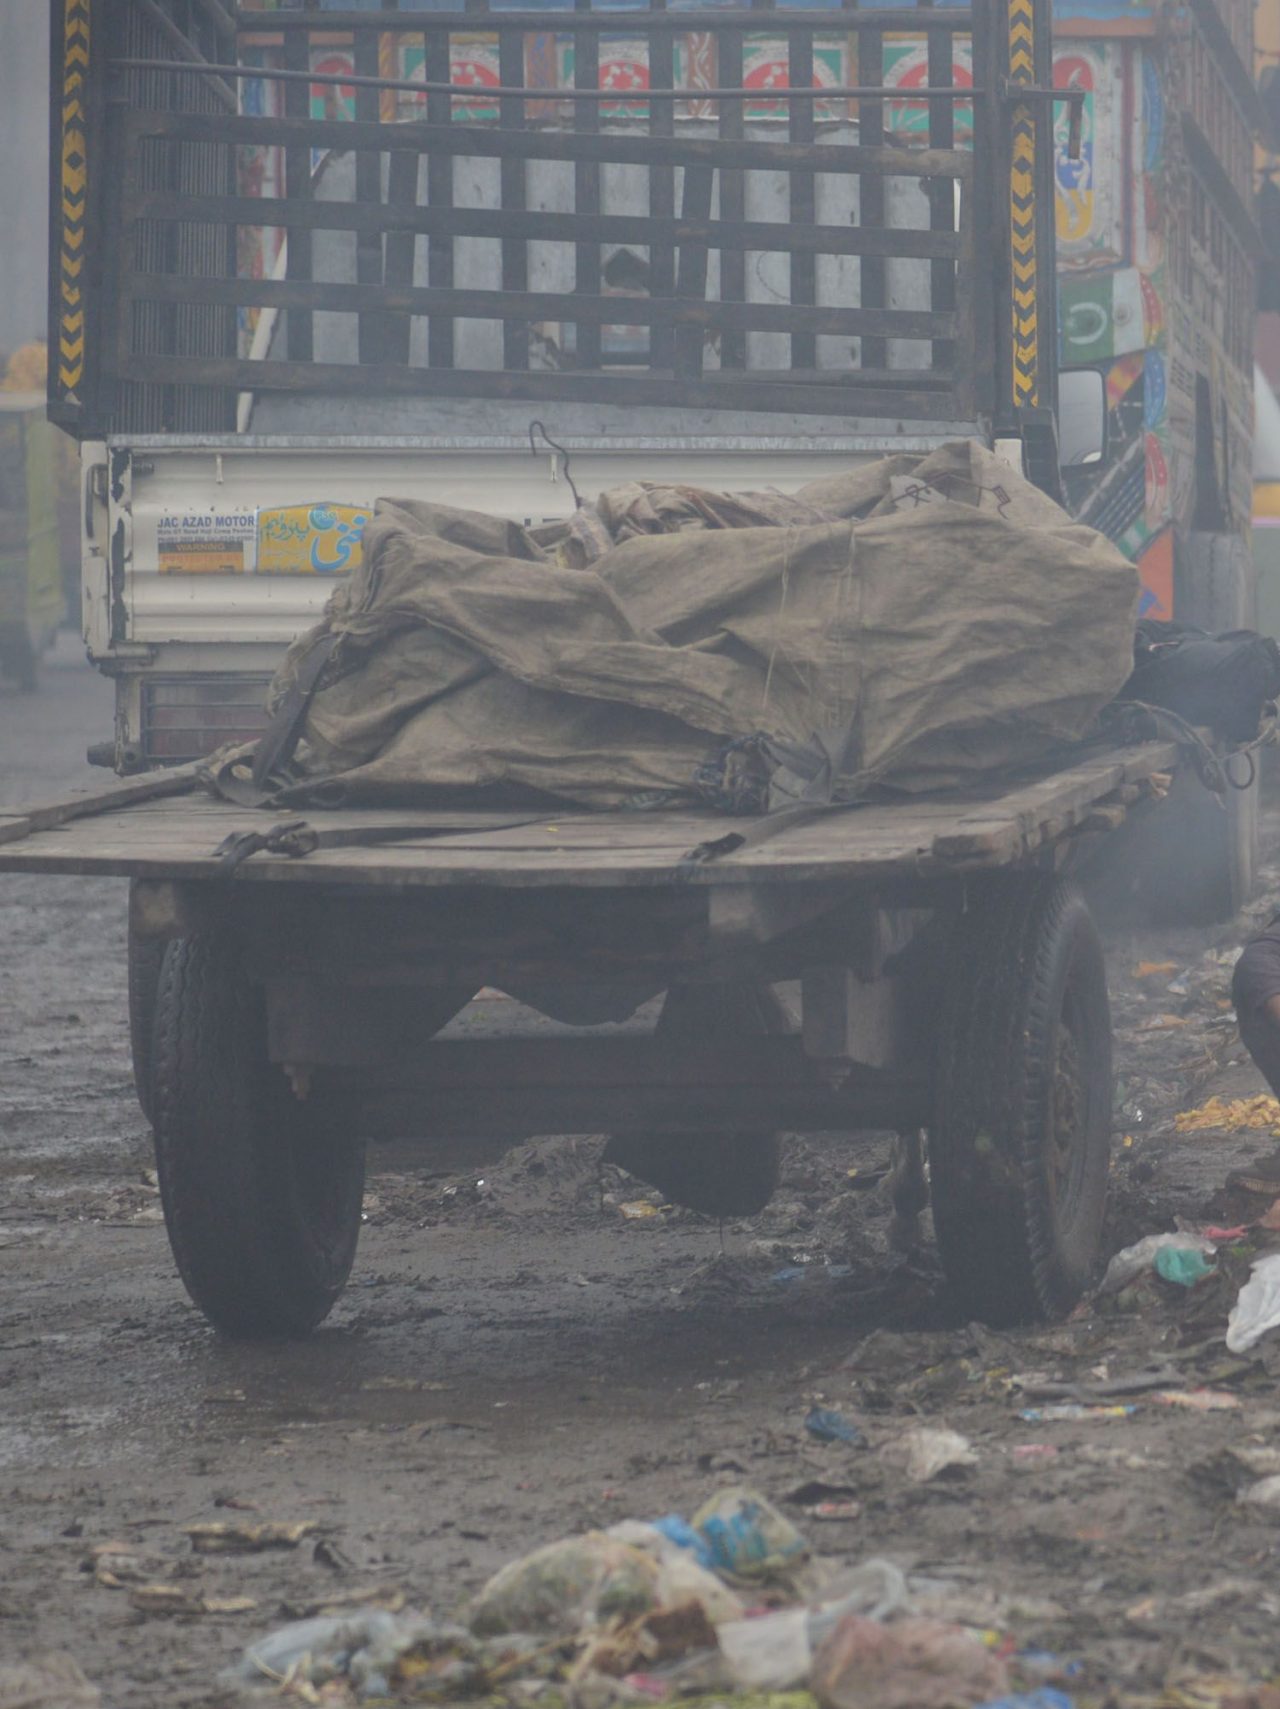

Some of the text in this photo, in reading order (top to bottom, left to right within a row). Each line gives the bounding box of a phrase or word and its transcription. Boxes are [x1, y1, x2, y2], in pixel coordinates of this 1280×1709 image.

[157, 515, 255, 528] JAC AZAD MOTOR
[176, 543, 225, 551] WARNING
